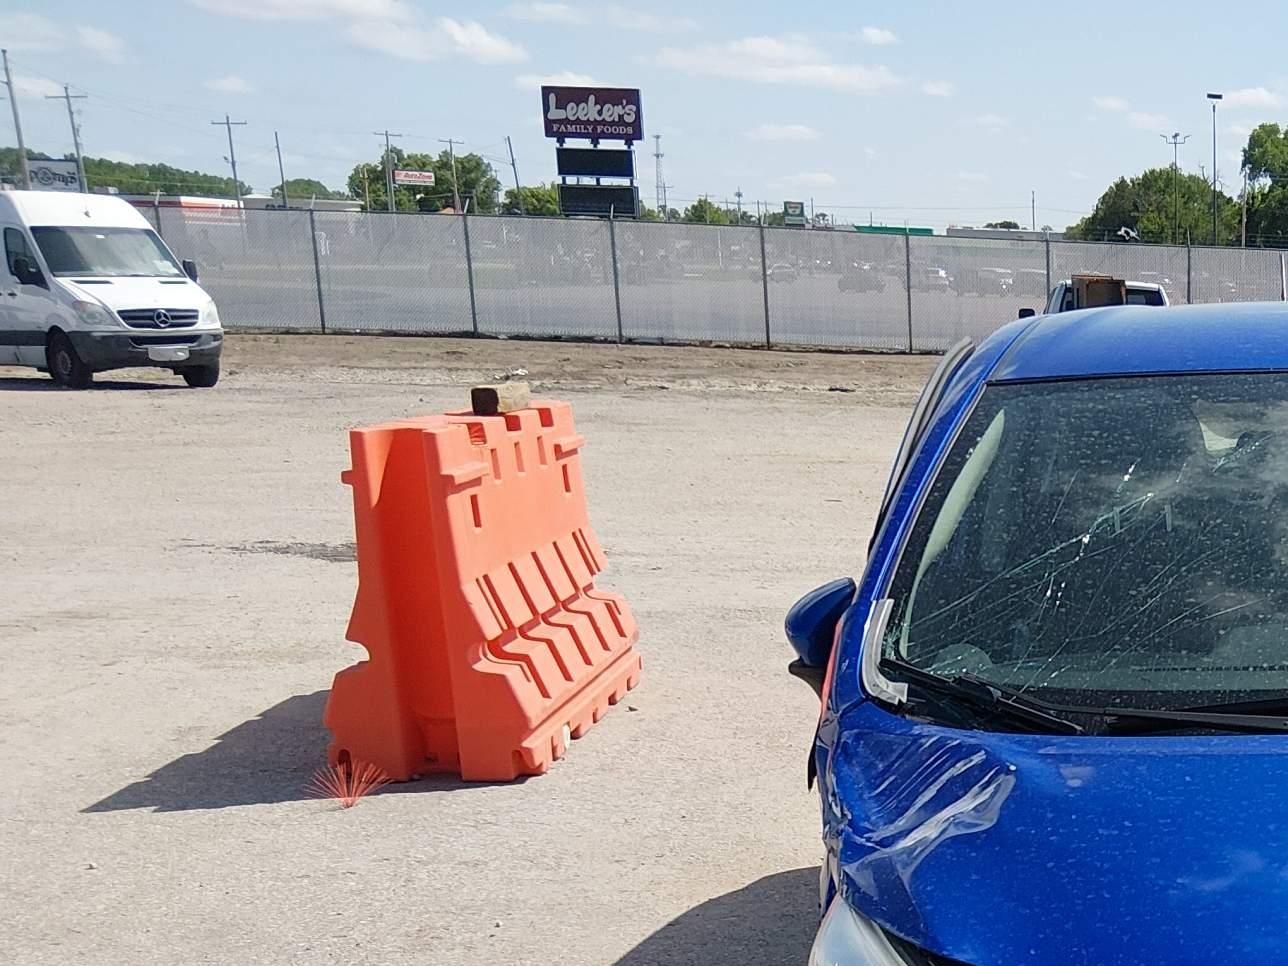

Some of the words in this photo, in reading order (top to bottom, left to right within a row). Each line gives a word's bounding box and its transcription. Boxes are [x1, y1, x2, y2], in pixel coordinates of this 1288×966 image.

[547, 92, 637, 123] Leeker's
[552, 123, 594, 133] FAMILY
[597, 125, 634, 135] FOODS
